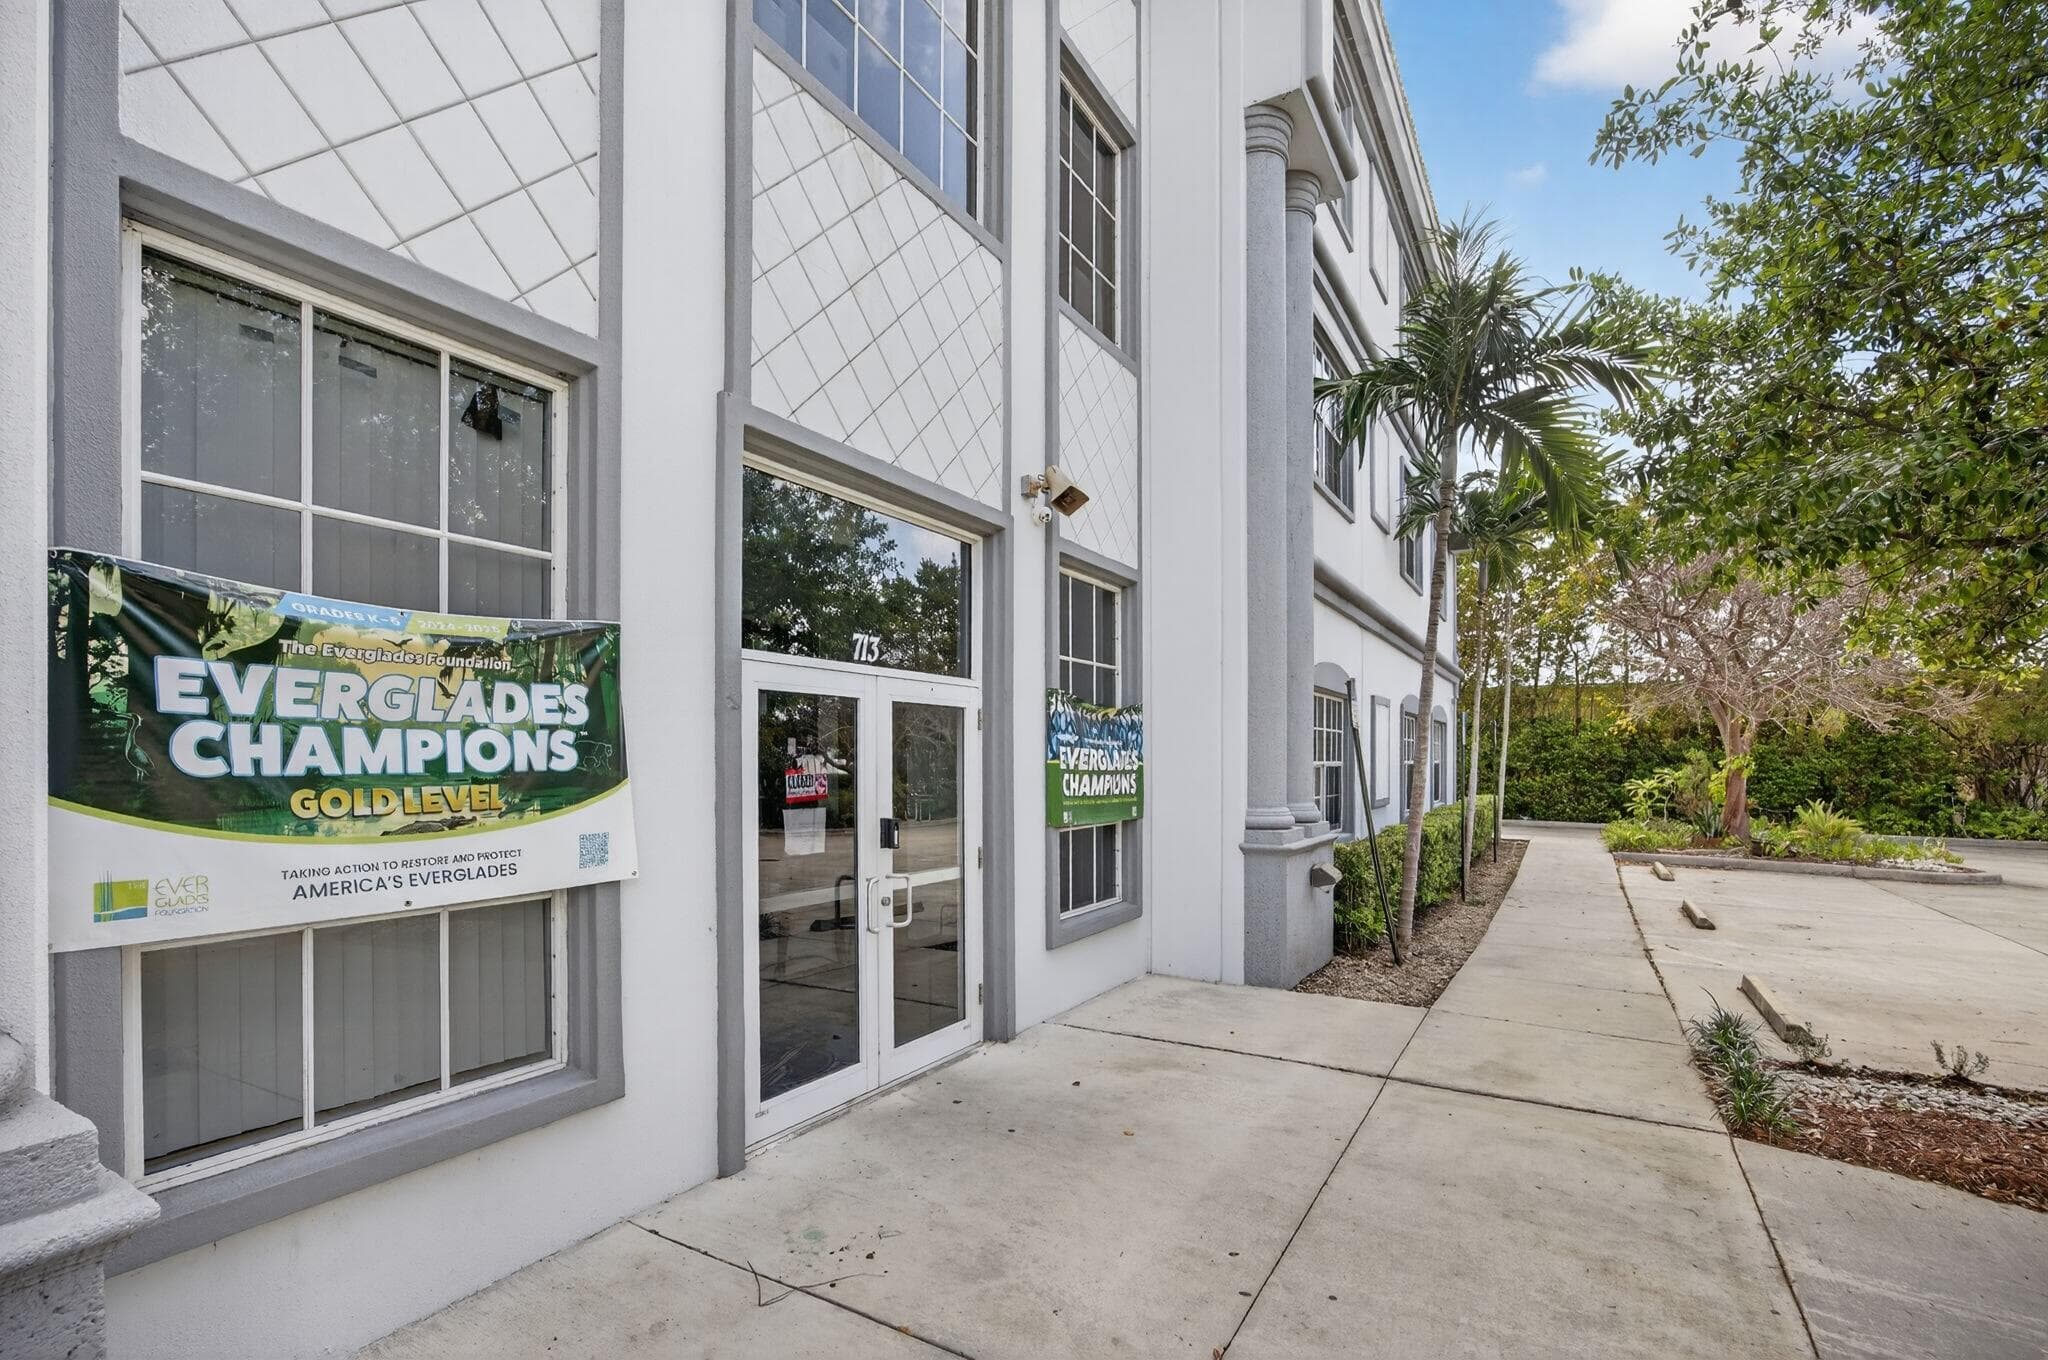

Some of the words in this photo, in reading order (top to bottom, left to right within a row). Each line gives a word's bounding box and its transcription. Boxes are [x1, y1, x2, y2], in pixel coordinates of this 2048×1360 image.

[279, 638, 317, 657] The
[321, 643, 423, 666] Everglades
[426, 653, 512, 672] Foundation
[852, 632, 881, 662] 713
[154, 655, 590, 726] EVERGLADES
[169, 727, 579, 777] CHAMPIONS
[290, 787, 399, 819] GOLD
[402, 783, 504, 815] LEVEL
[1062, 773, 1137, 796] CHAMPIONS
[281, 866, 331, 880] TAKING
[334, 861, 380, 875] ACTION
[384, 860, 398, 871] TO
[401, 855, 449, 869] RESTORE
[452, 853, 475, 863] AND
[477, 848, 522, 862] PROTECT
[292, 874, 403, 901] AMERICA'S
[409, 862, 518, 888] EVERGLADES
